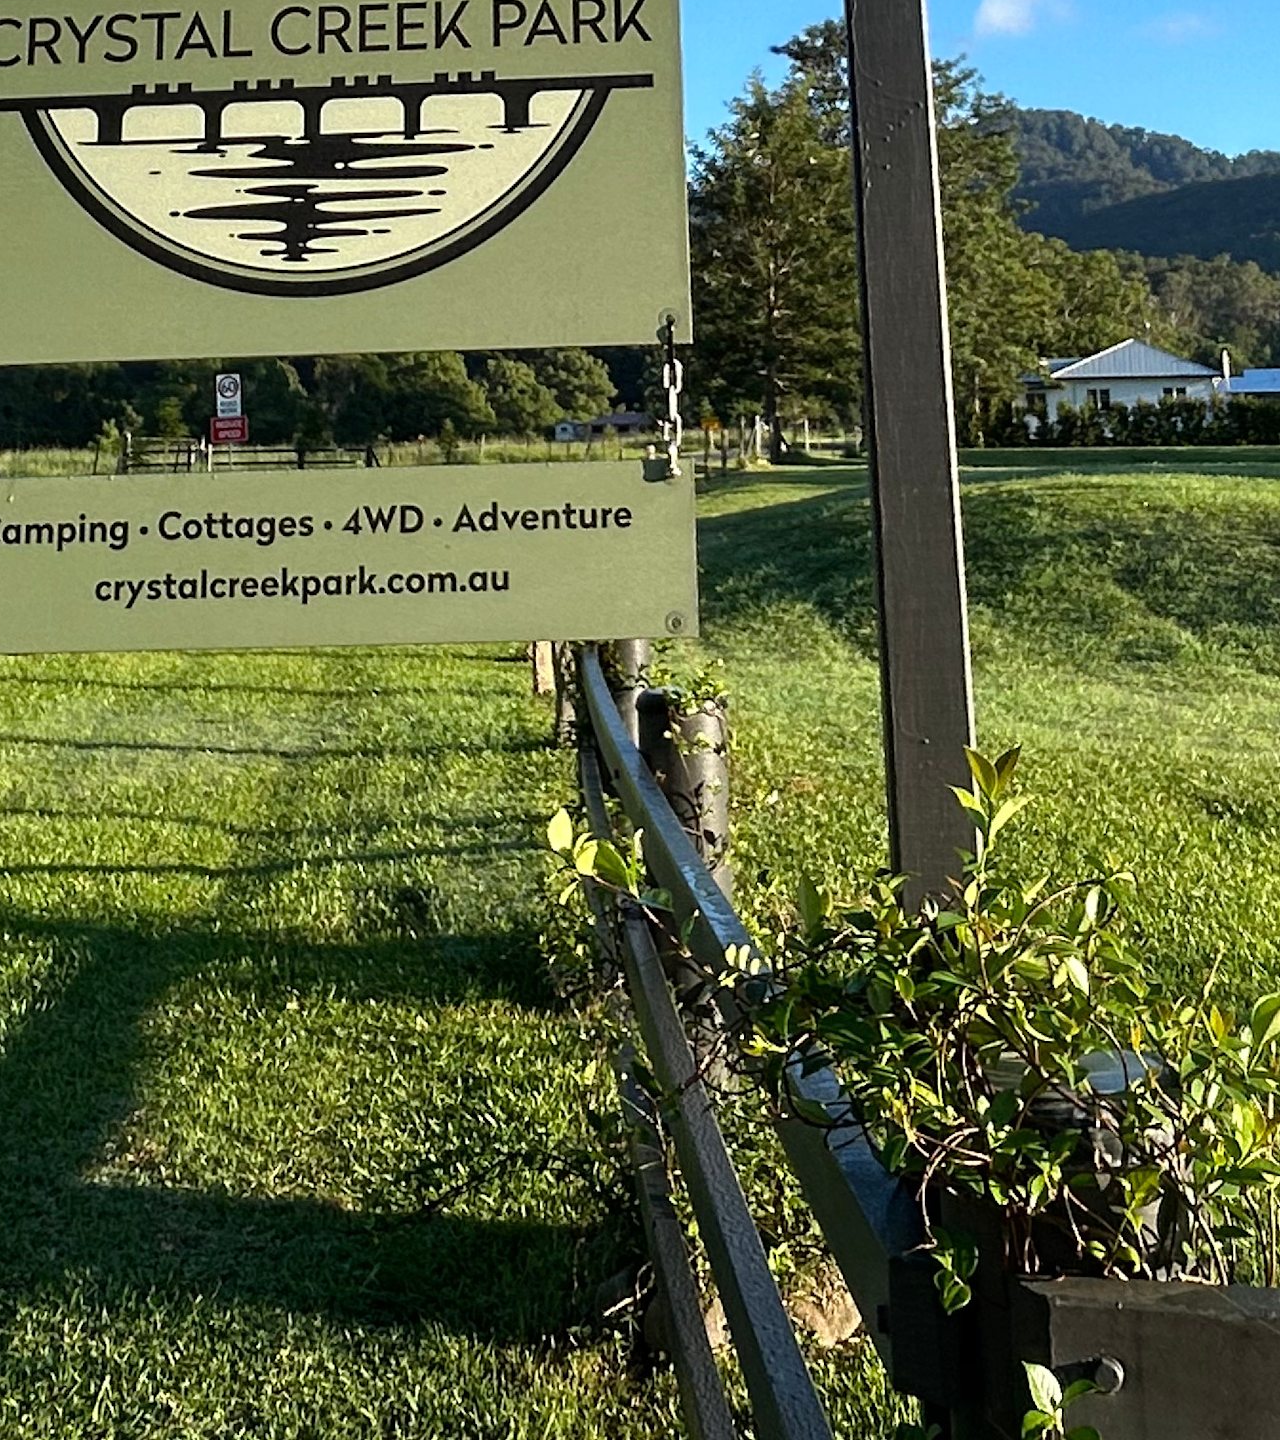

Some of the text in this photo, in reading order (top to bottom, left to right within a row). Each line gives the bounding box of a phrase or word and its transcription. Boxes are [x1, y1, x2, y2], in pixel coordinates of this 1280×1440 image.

[270, 0, 472, 56] CREEK
[158, 511, 314, 547] Cottages
[341, 505, 424, 535] 4WD
[452, 503, 633, 533] Adventure
[95, 565, 510, 609] crystalcreekpark.com.au
